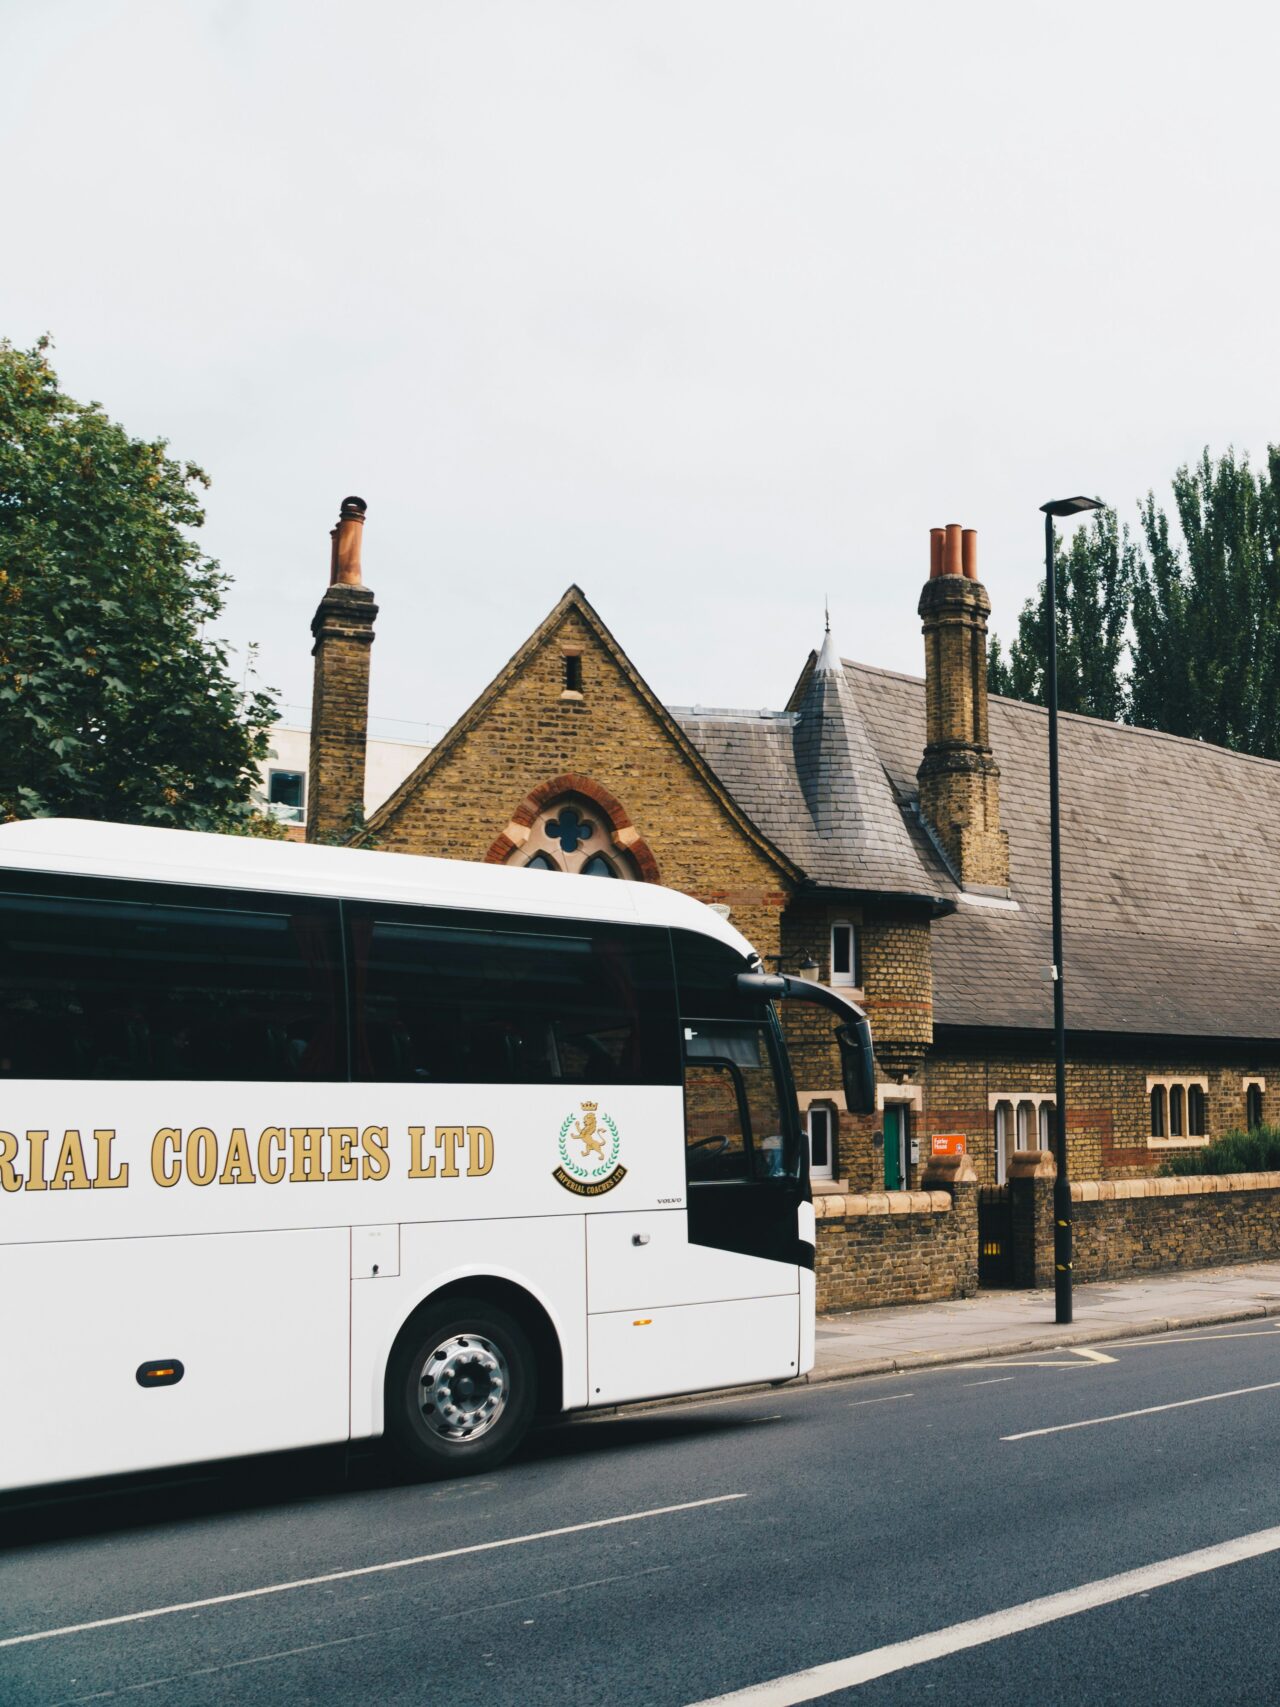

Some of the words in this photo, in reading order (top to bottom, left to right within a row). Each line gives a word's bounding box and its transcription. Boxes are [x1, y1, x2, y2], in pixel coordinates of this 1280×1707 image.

[150, 1125, 390, 1188] COACHES
[408, 1126, 495, 1178] LTD
[556, 1170, 585, 1193] IMPERIAL
[586, 1179, 614, 1194] COACHES
[612, 1168, 625, 1182] LTD
